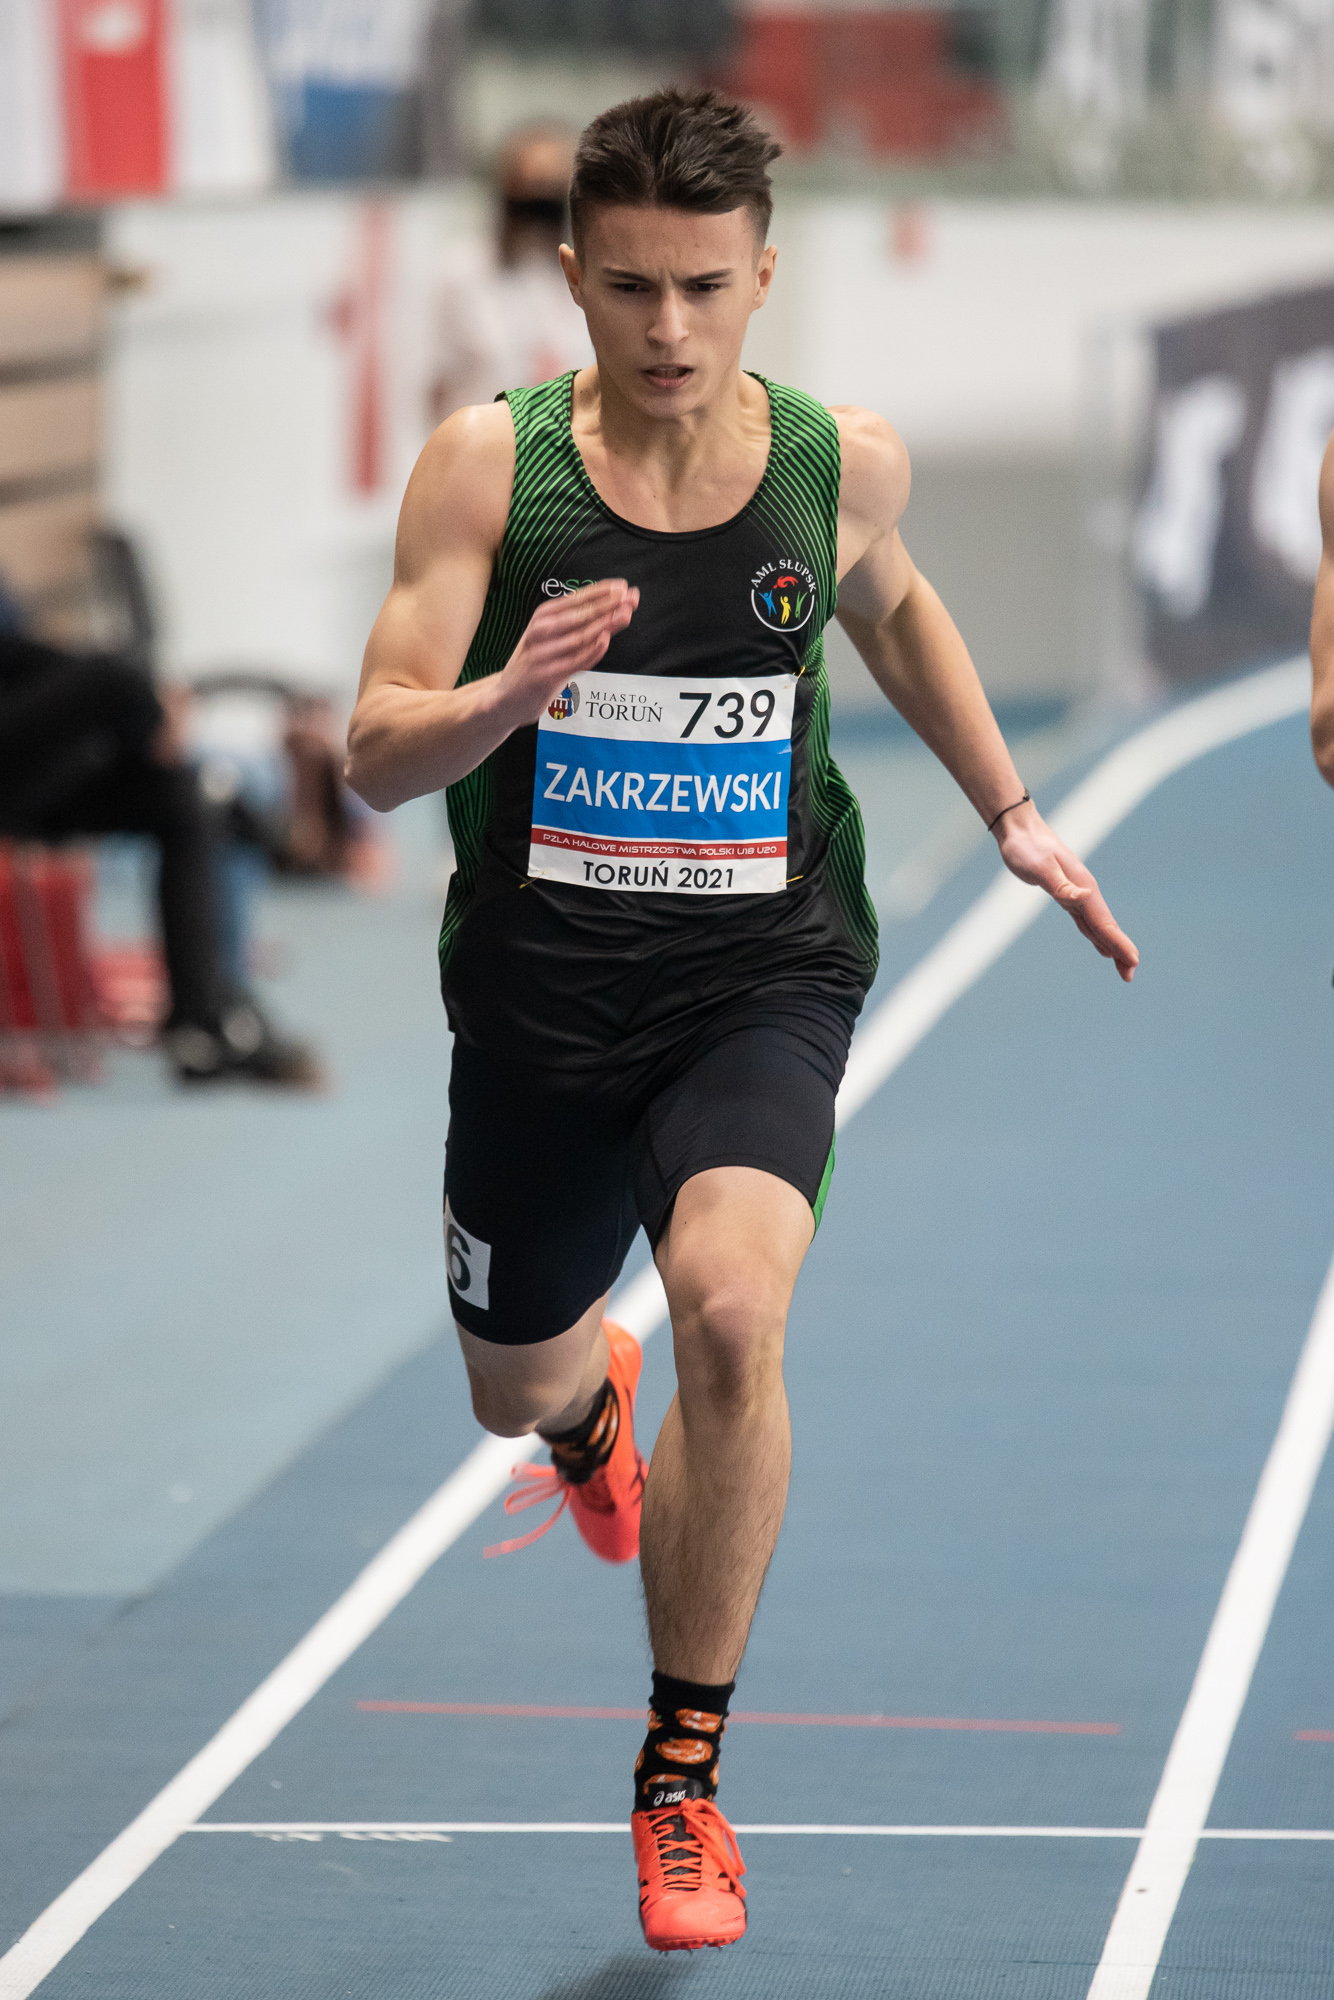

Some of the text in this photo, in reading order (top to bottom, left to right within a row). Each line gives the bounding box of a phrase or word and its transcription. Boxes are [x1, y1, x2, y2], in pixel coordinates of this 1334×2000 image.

[751, 559, 817, 593] AML SŁUPSK
[585, 702, 663, 723] TORUŃ
[590, 690, 647, 704] MIASTO
[679, 689, 776, 739] 739
[543, 762, 782, 813] ZAKRZEWSKI
[543, 833, 777, 856] PZLA HALOWE MISTRZOSTWA POLSKI U18 U20
[583, 860, 734, 889] TORUŃ 2021
[447, 1223, 471, 1292] 6
